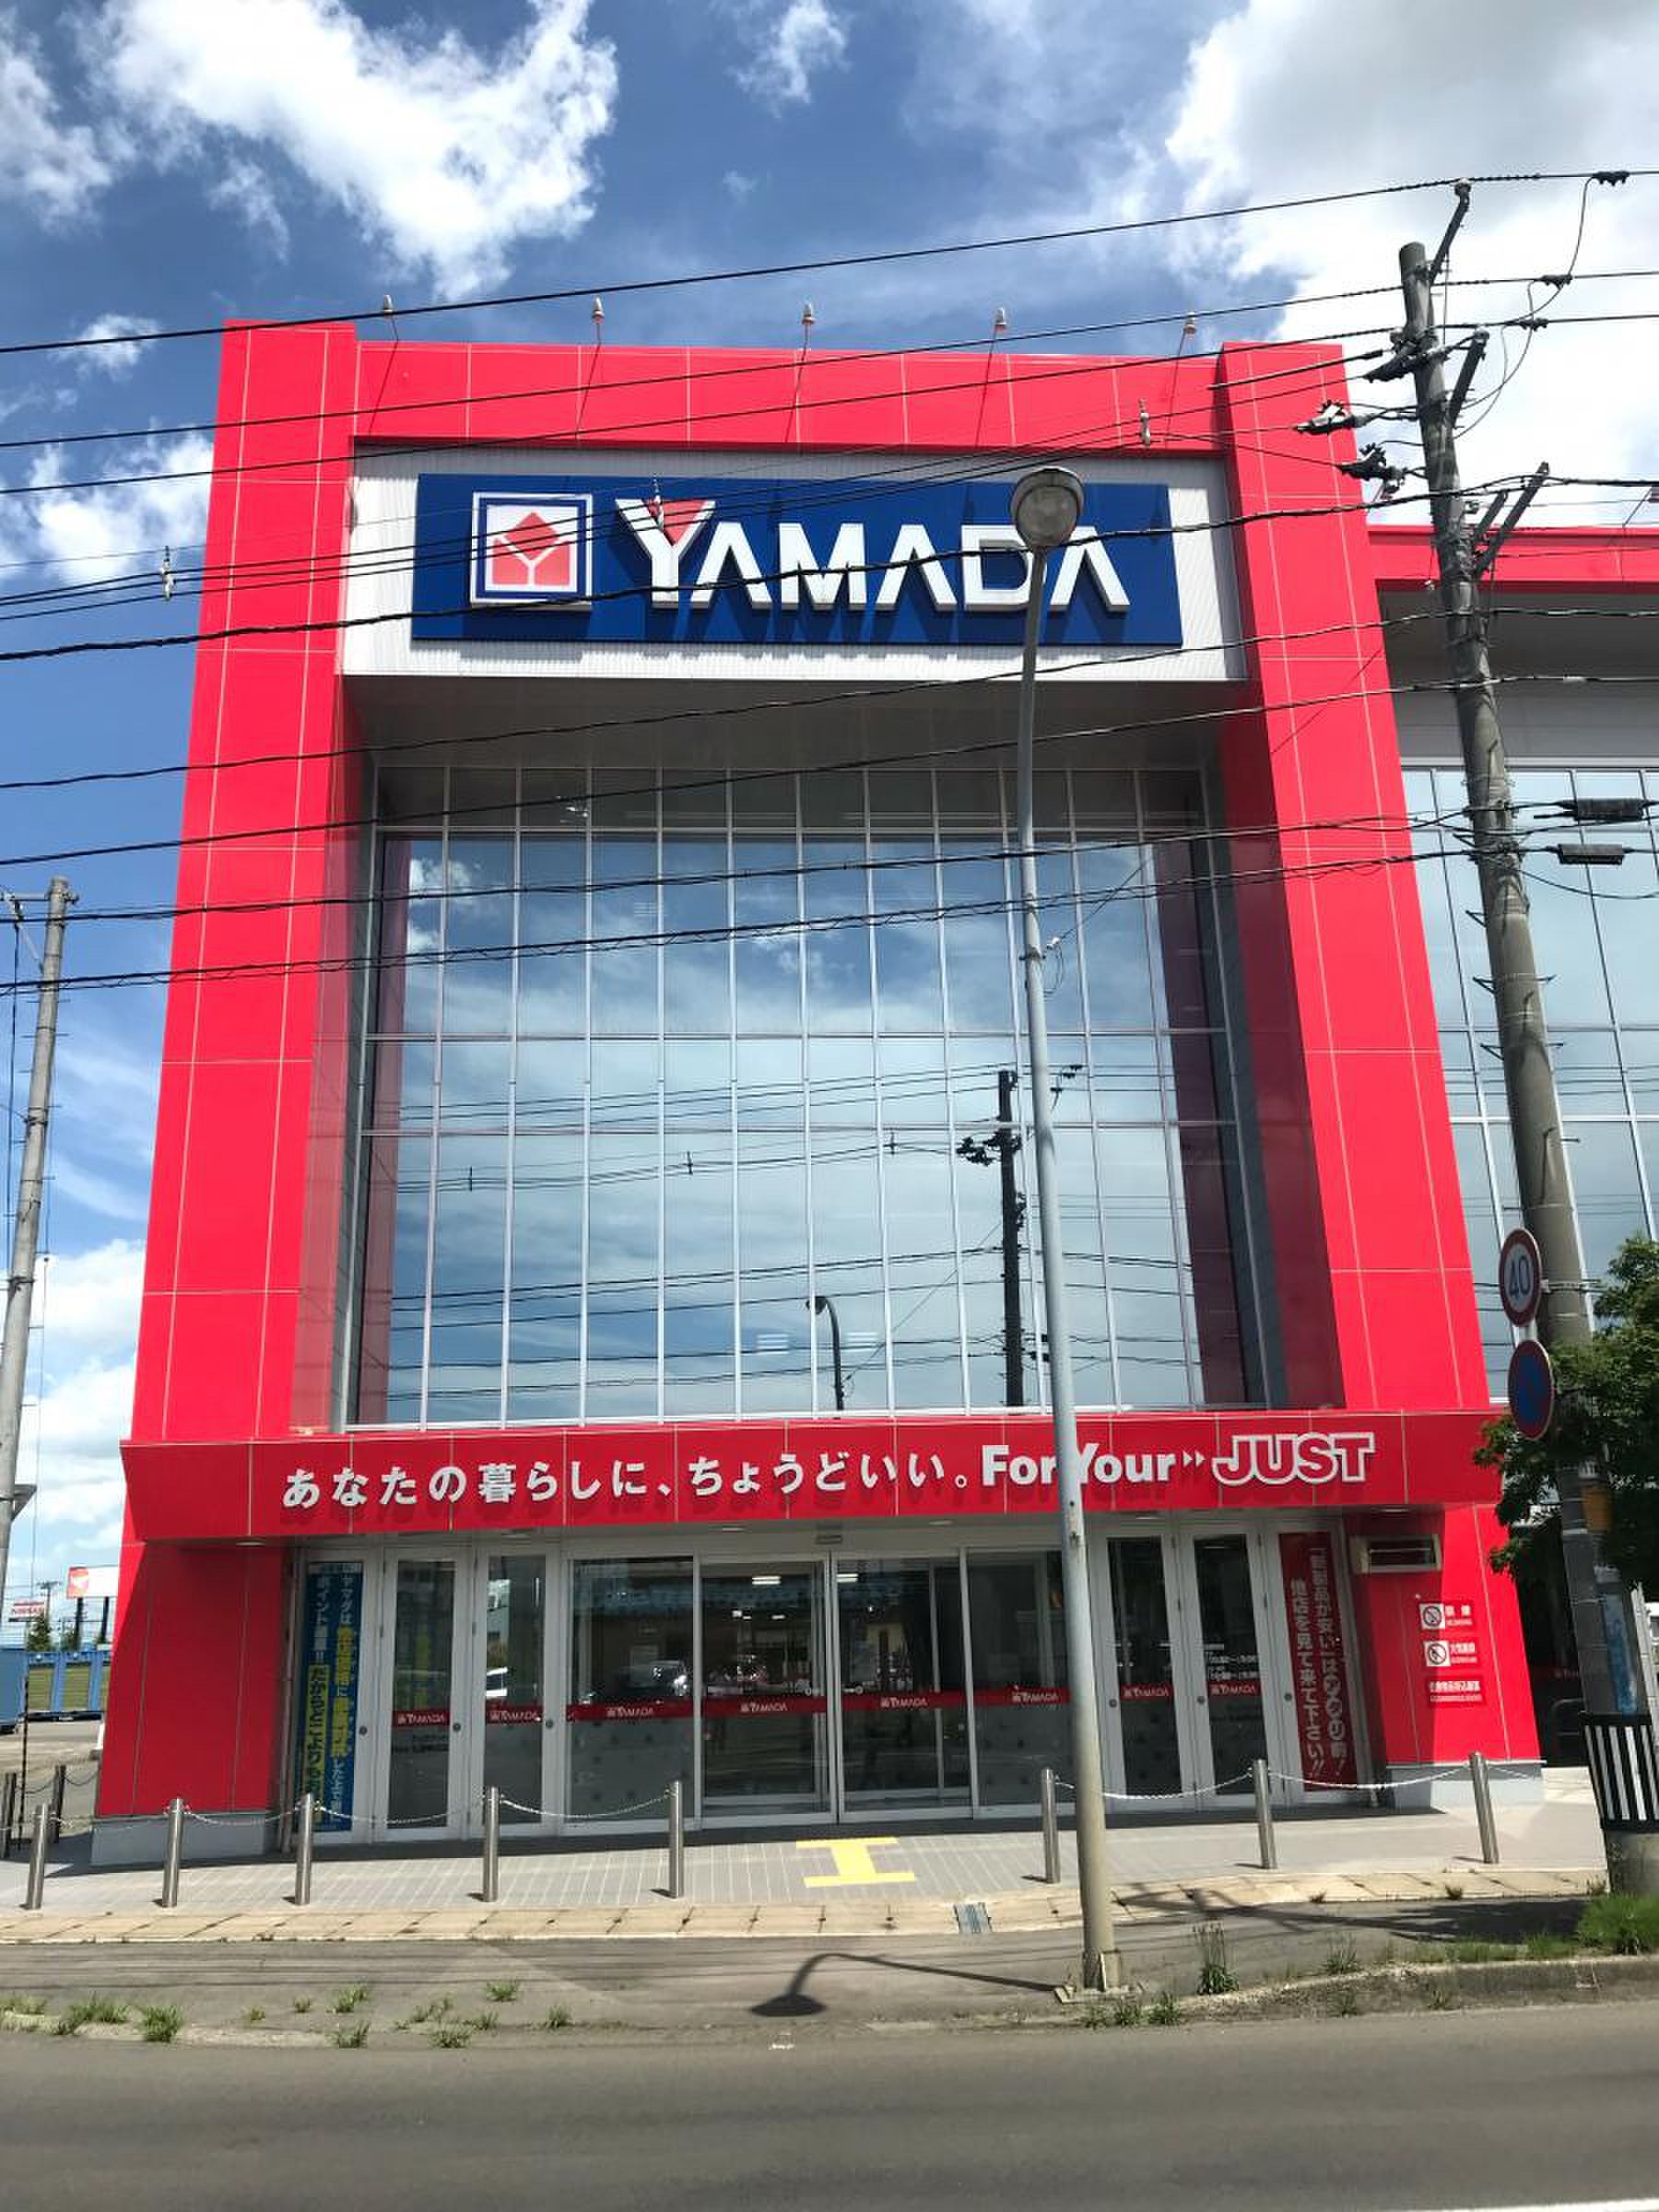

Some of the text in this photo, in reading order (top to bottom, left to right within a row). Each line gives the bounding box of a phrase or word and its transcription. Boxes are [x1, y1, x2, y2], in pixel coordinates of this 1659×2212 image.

[616, 498, 1130, 613] YAMADA
[1510, 1255, 1533, 1300] 40
[282, 1451, 969, 1509] あなたの暮らしに、ちょうどいい。
[982, 1444, 1057, 1486] For
[1212, 1431, 1375, 1487] JUST
